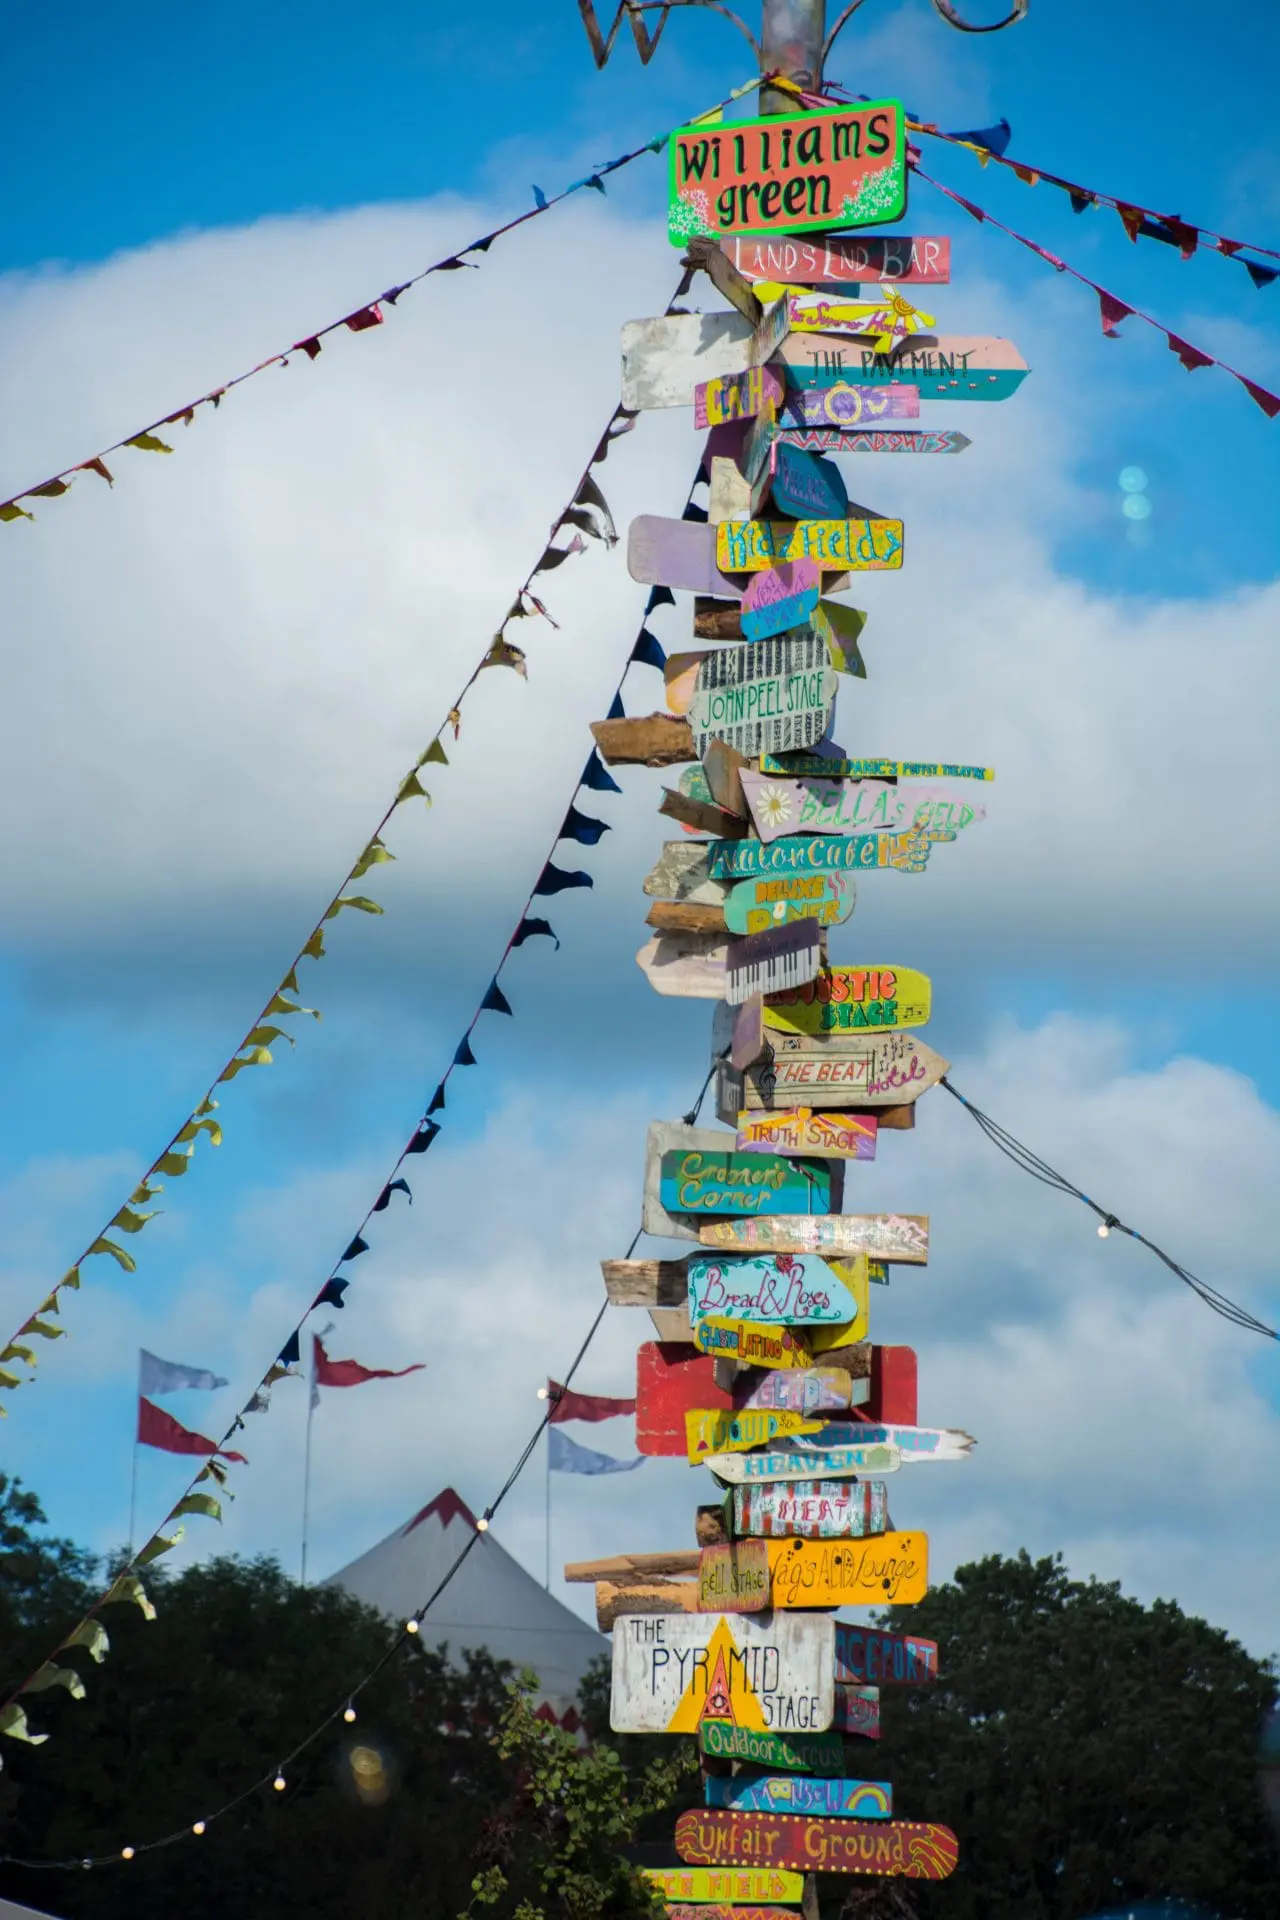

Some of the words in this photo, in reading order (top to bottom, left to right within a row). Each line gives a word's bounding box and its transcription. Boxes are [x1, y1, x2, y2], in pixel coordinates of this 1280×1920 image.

[715, 172, 833, 228] green
[878, 239, 941, 281] BAR
[806, 350, 848, 378] THE
[861, 350, 977, 379] PAVEMENT
[701, 688, 745, 729] JOHN
[746, 680, 784, 720] PEEL
[786, 671, 825, 711] STAGE
[799, 786, 905, 827] BELLA'S
[820, 1000, 898, 1030] STAGE
[771, 1062, 811, 1082] THE
[816, 1060, 870, 1082] BEAT
[750, 1123, 799, 1146] TRUTH
[806, 1124, 859, 1151] STAGE
[744, 1450, 864, 1477] HEAVEN
[778, 1499, 849, 1521] MEAT
[630, 1618, 666, 1643] THE
[651, 1643, 780, 1696] PYRAMID
[762, 1695, 819, 1729] STAGE
[706, 1870, 788, 1900] FIELD
